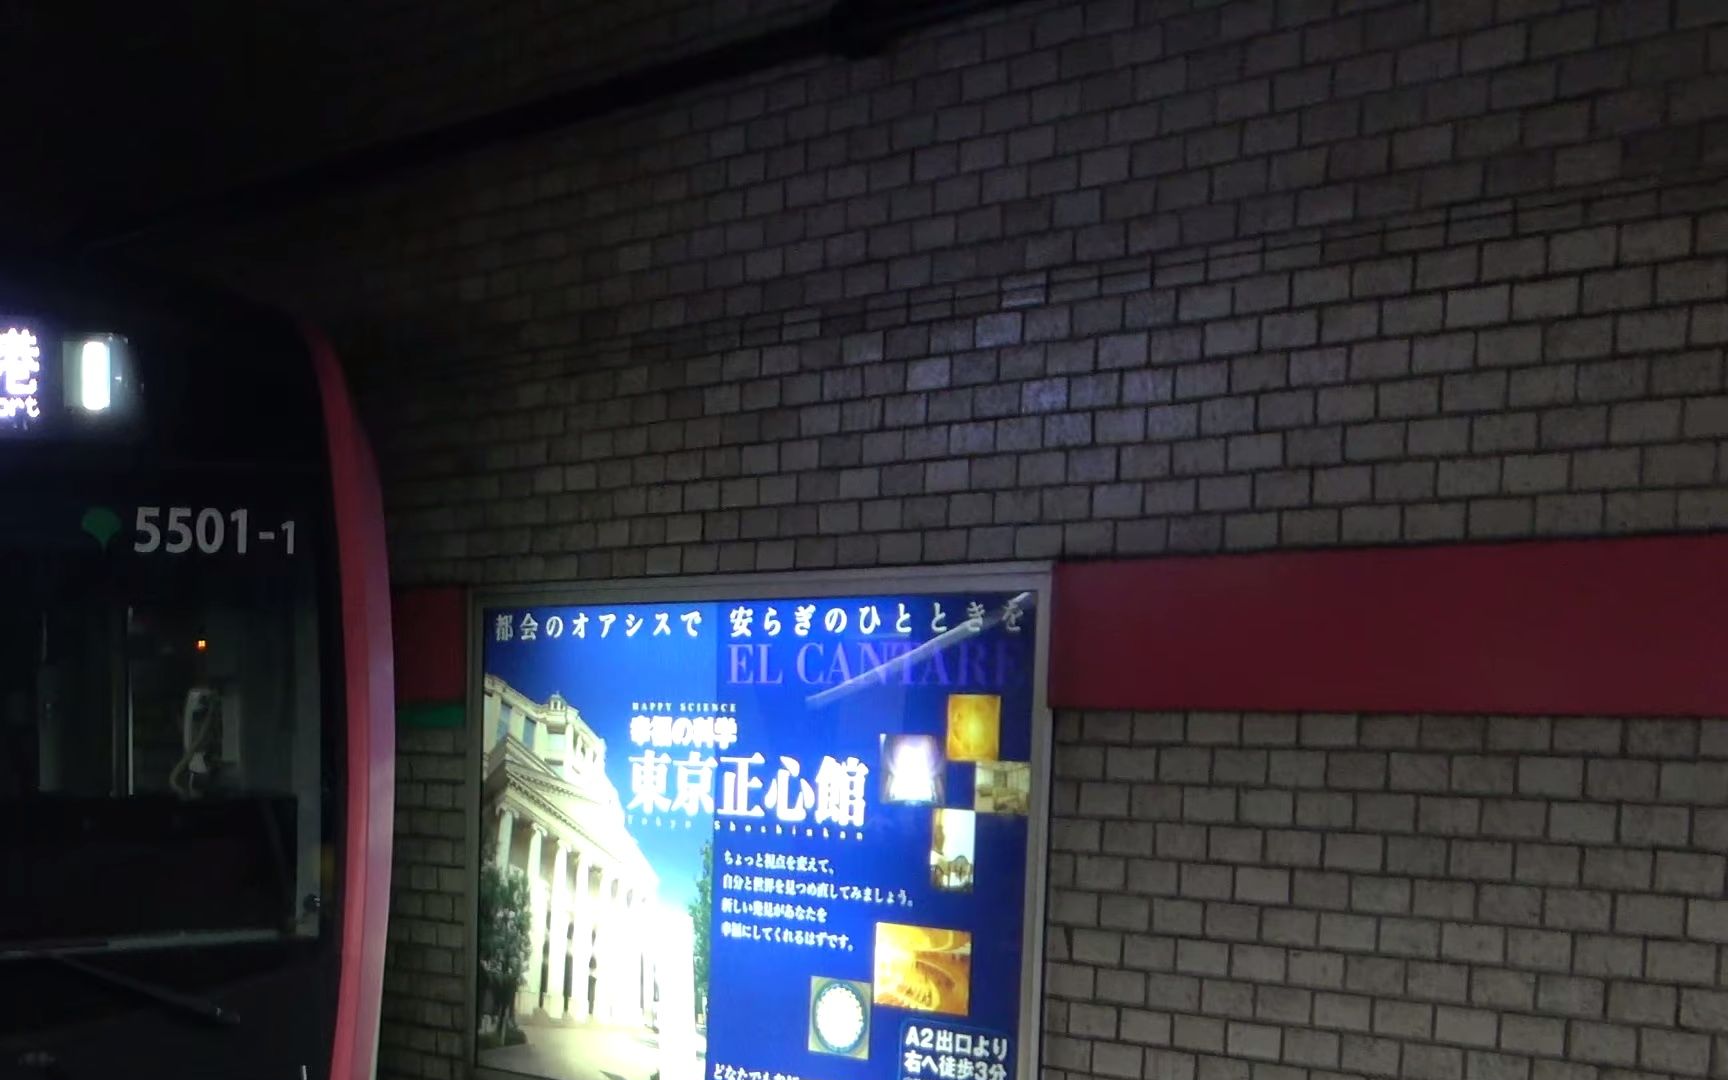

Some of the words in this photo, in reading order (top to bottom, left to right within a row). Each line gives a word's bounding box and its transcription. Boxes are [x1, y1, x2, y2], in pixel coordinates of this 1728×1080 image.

[133, 506, 295, 554] 5501-1
[495, 611, 702, 641] 都会のオアシスで
[729, 600, 1024, 638] 安らぎのひとときを
[726, 643, 783, 685] EL
[679, 702, 737, 714] SCIENCE
[629, 715, 738, 750] 幸福の科学
[626, 749, 870, 827] 東京正心館
[905, 1025, 1008, 1061] A2出口より
